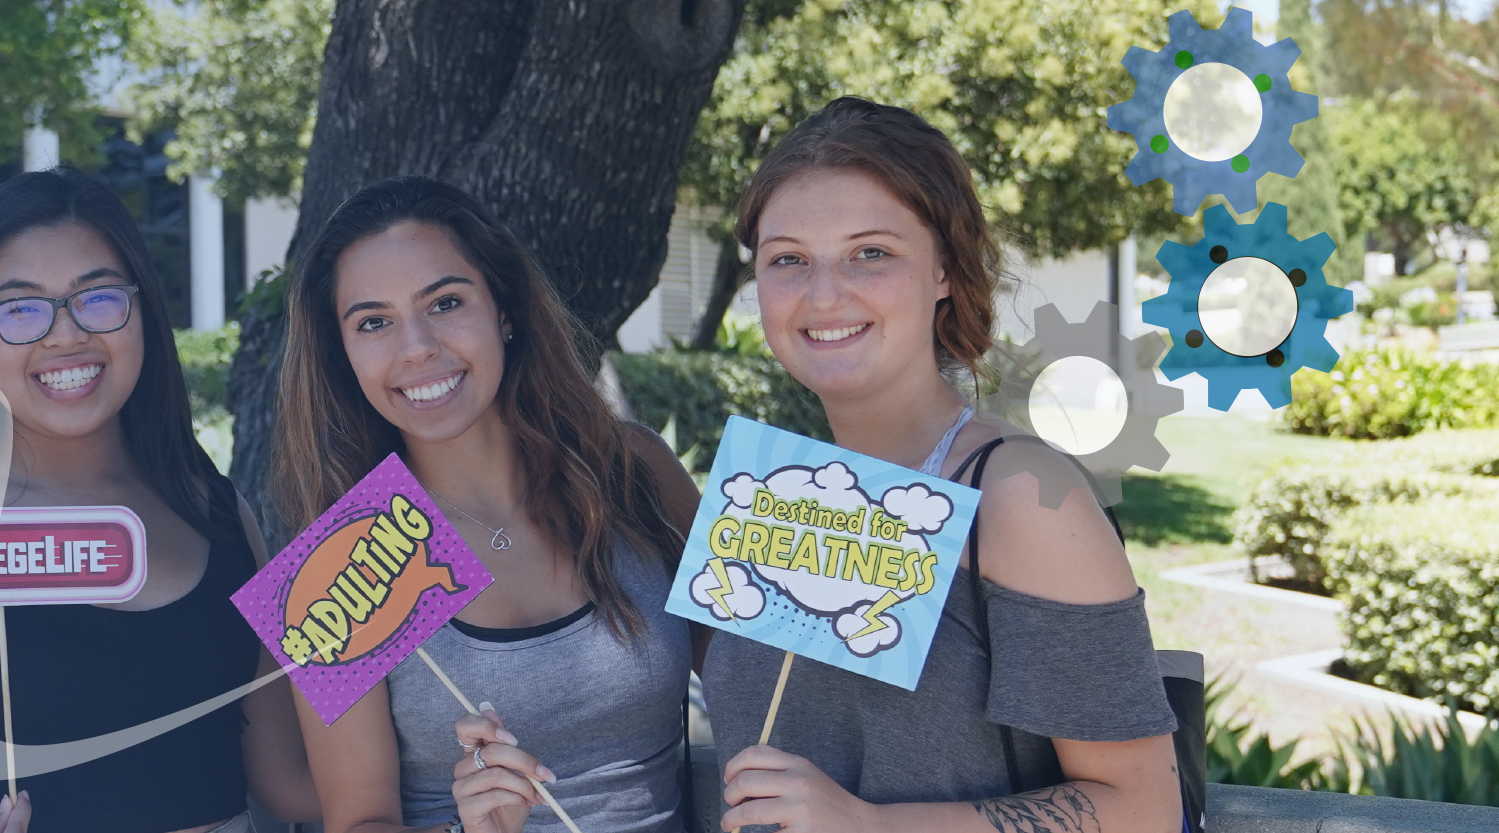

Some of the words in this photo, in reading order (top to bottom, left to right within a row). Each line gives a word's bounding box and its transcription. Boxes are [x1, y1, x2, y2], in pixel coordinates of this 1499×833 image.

[708, 515, 939, 596] GREATNESS
[752, 489, 867, 536] Destined
[870, 508, 908, 542] for
[280, 493, 434, 668] #ADULTING
